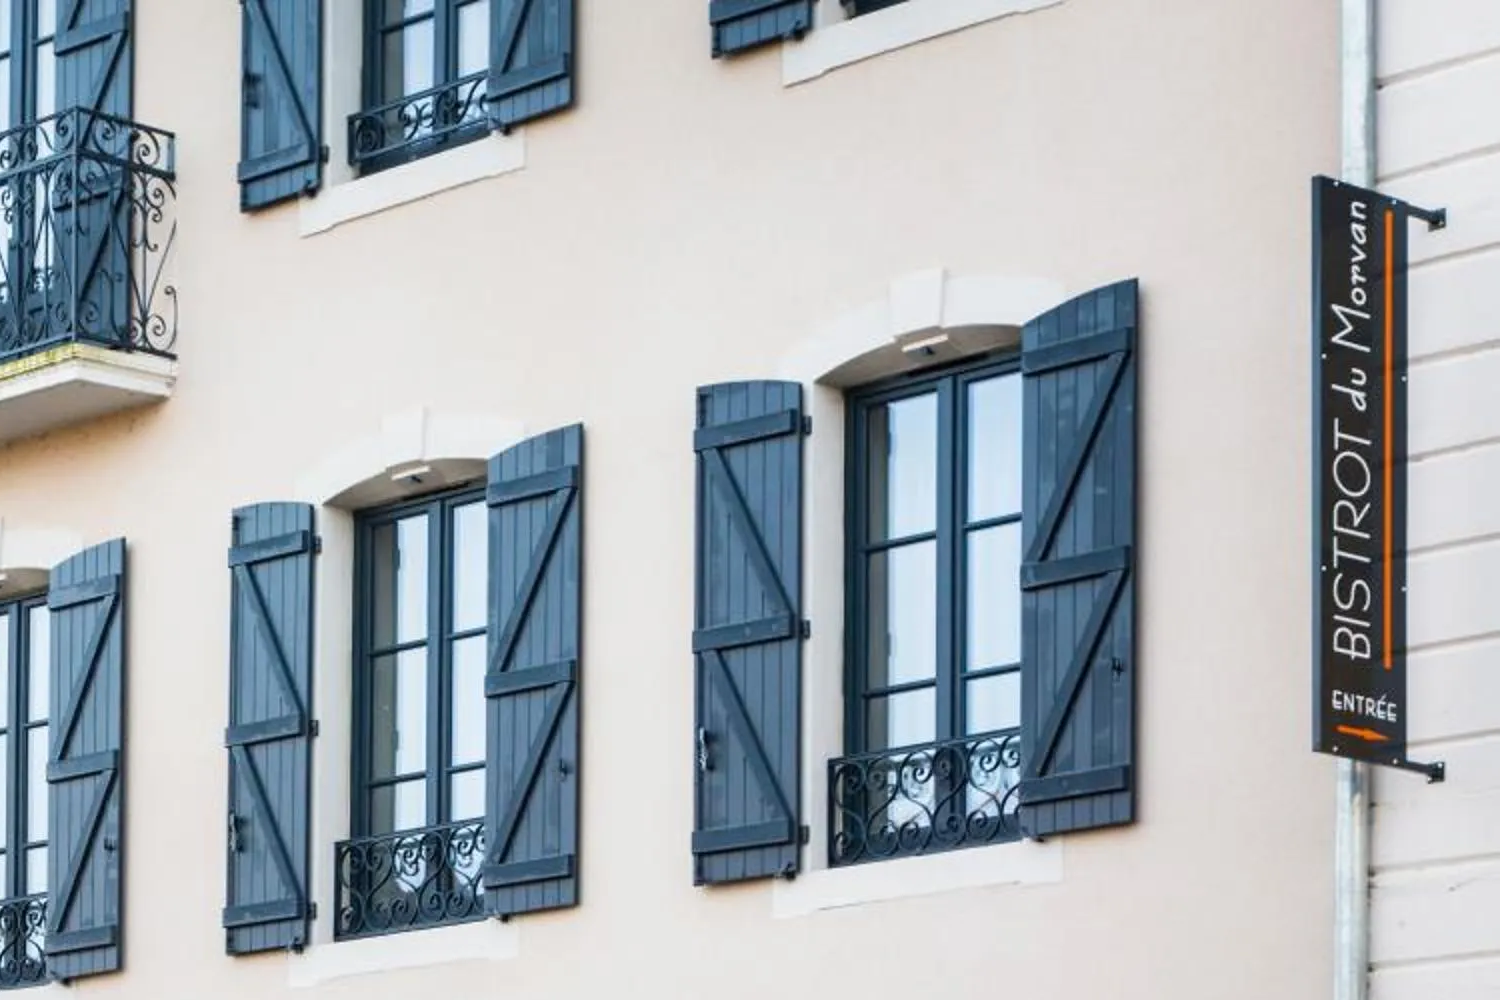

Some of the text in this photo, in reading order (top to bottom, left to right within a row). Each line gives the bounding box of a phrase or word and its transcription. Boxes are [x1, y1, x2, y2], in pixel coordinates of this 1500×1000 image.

[1330, 200, 1373, 660] BISTROT du Morvan
[1331, 689, 1397, 722] ENTRÉE
